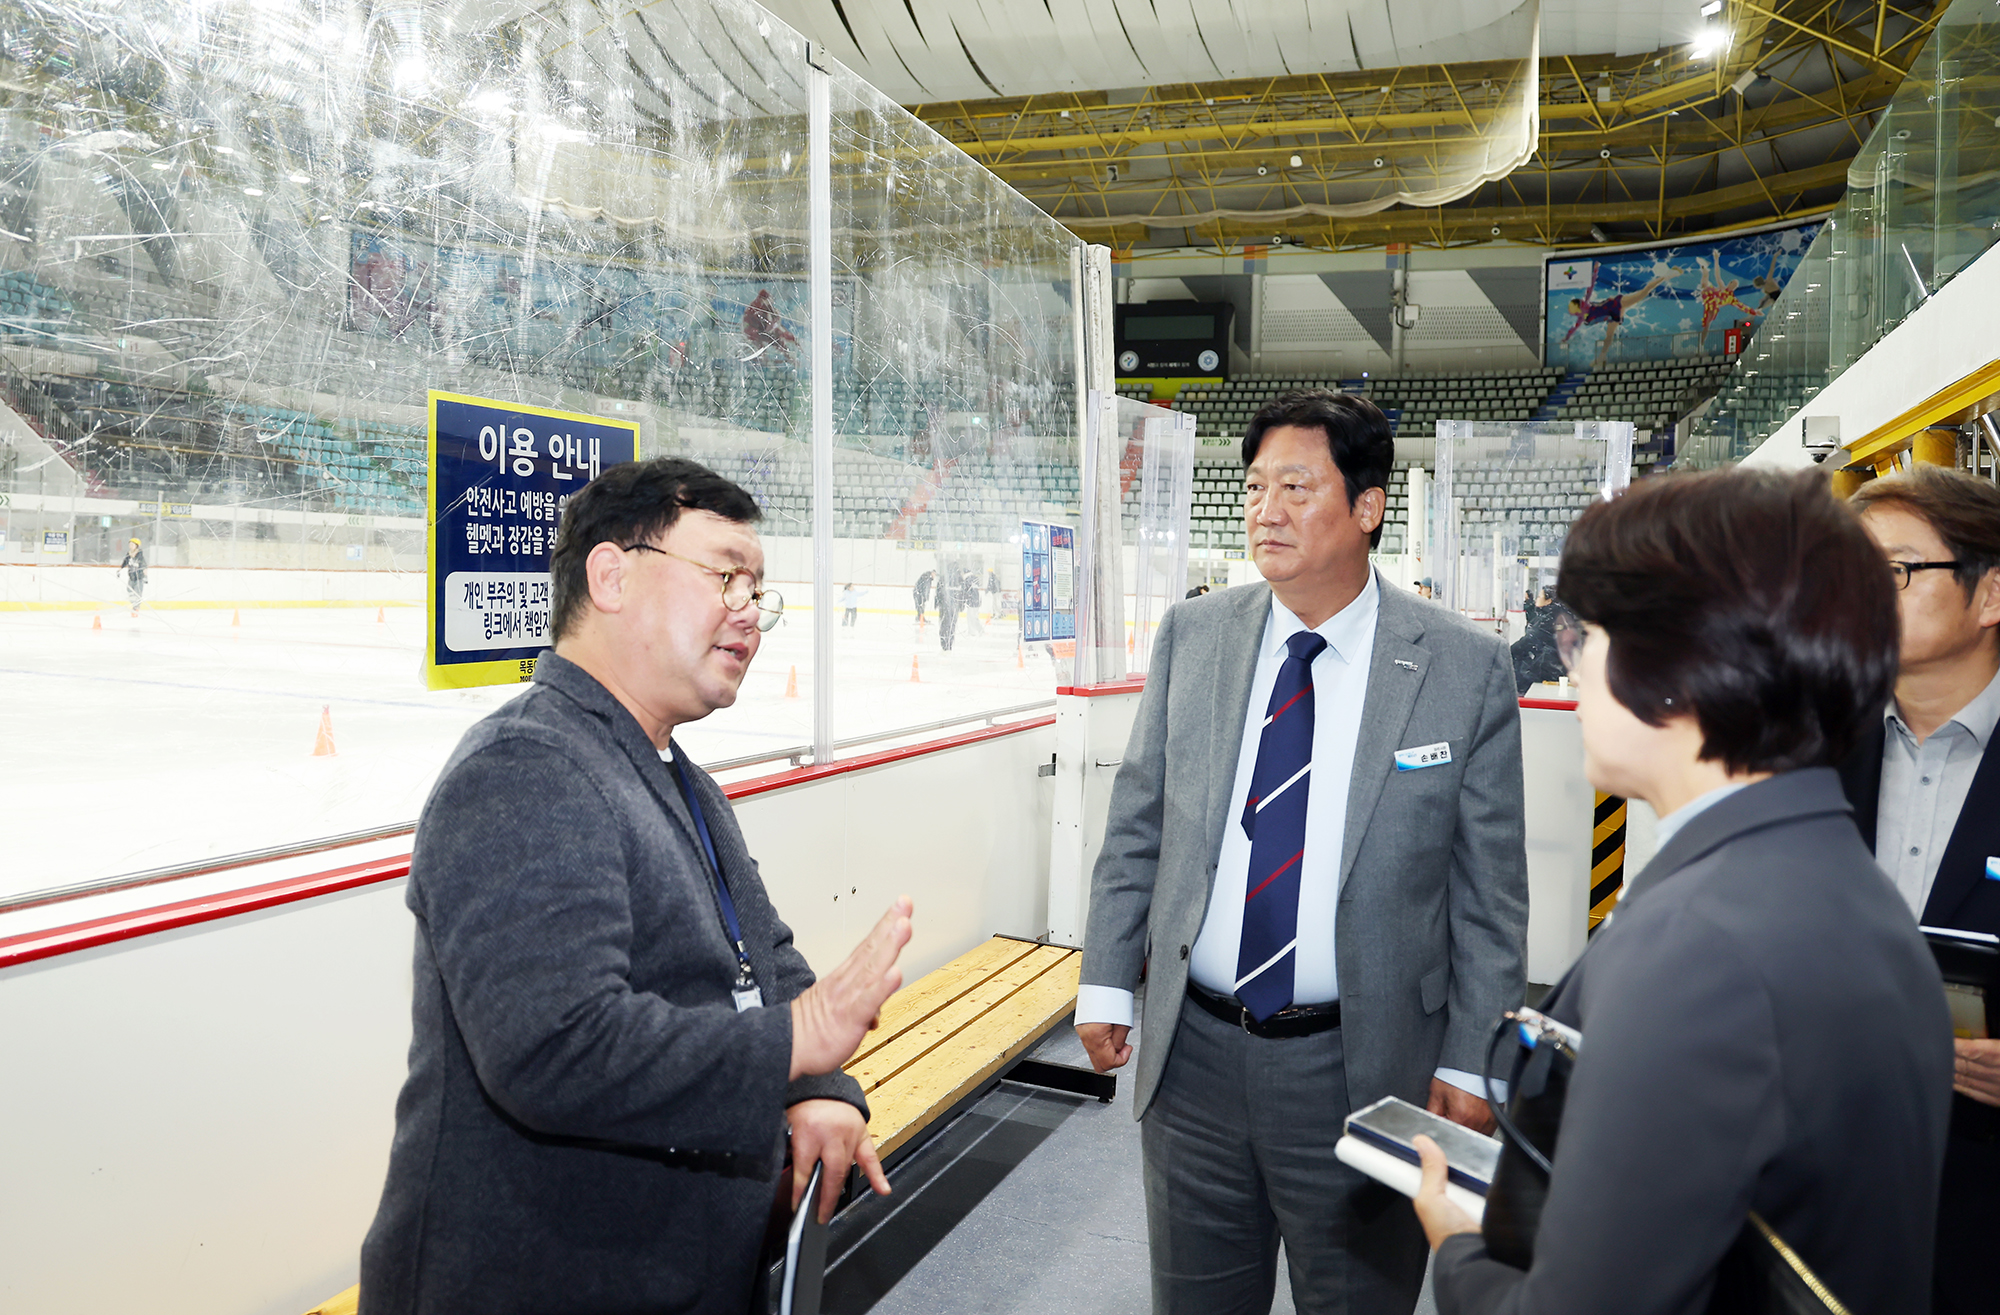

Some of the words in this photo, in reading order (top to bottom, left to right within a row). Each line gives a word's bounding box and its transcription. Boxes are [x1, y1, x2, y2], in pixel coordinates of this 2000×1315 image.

[478, 424, 539, 477] 이용
[548, 433, 600, 482] 안내
[466, 486, 517, 518] 안전사고
[520, 490, 556, 521] 예방을
[466, 522, 505, 555] 헬멧과
[508, 525, 544, 556] 장갑을
[463, 581, 484, 610] 개인
[487, 581, 515, 609] 부주의
[519, 581, 528, 609] 및
[530, 581, 549, 608] 고객
[483, 611, 521, 640] 링크에서
[524, 610, 551, 638] 책임지
[519, 660, 537, 674] 목동
